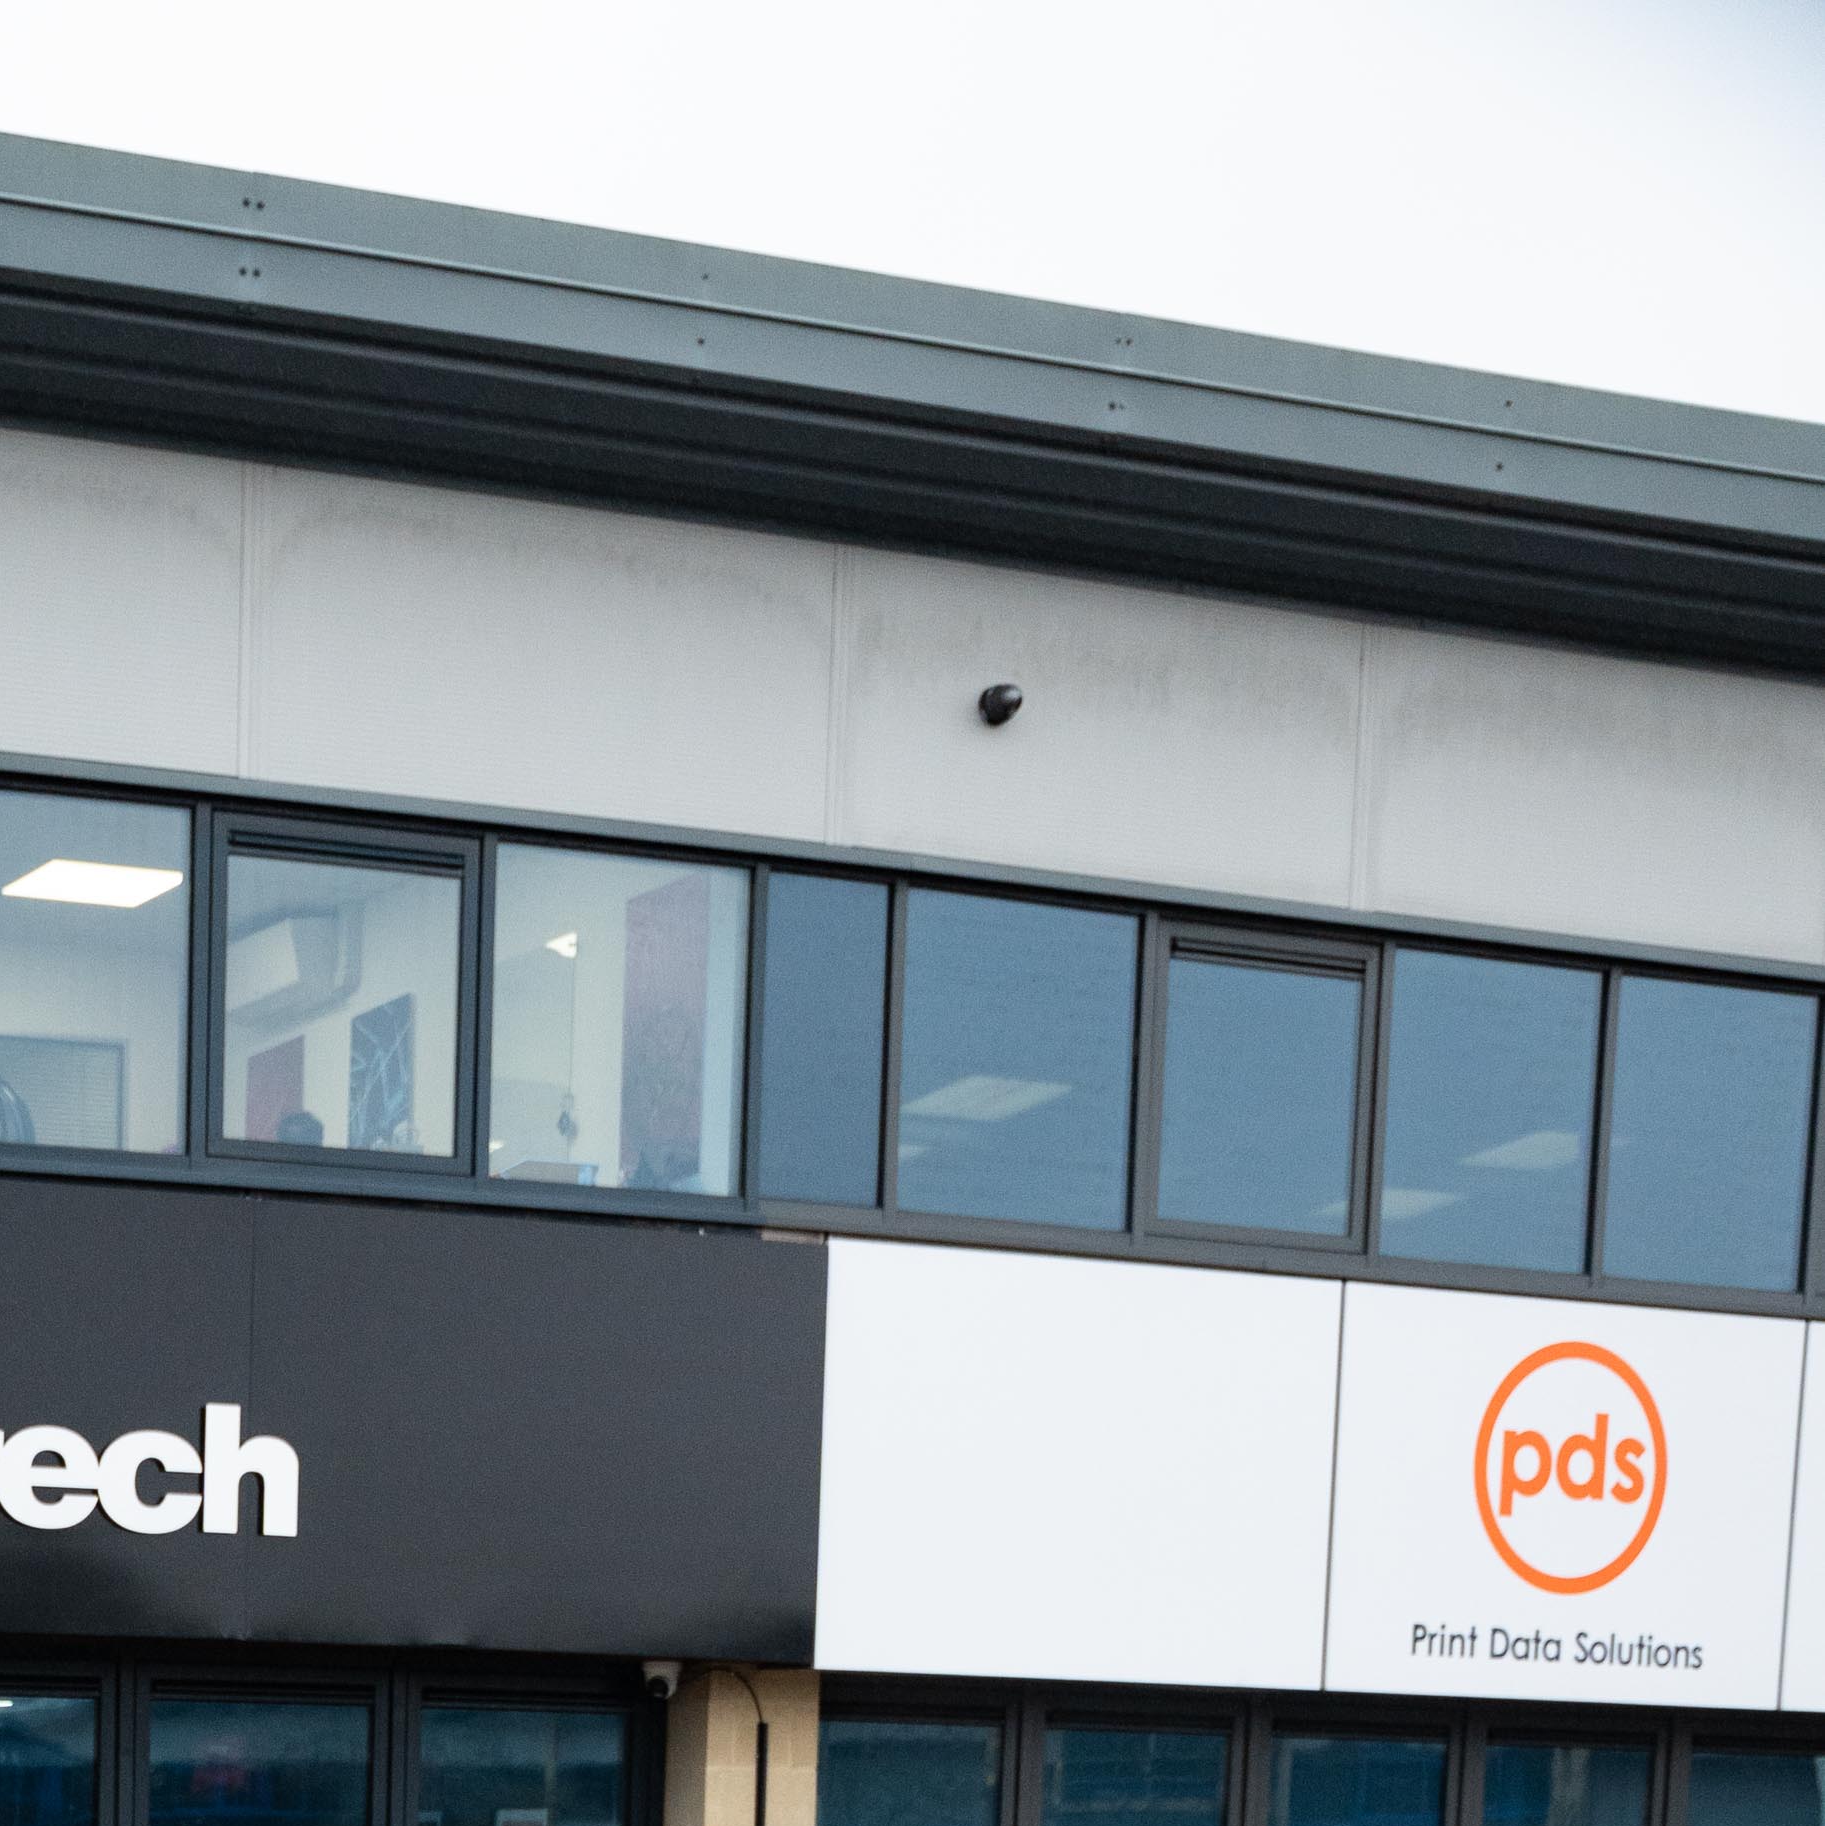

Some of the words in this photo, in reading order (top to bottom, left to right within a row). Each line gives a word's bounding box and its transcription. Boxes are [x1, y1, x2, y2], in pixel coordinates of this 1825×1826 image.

[1499, 1412, 1647, 1517] pds
[1411, 1623, 1478, 1657] Print
[1488, 1628, 1562, 1662] Data
[1574, 1631, 1704, 1670] Solutions
